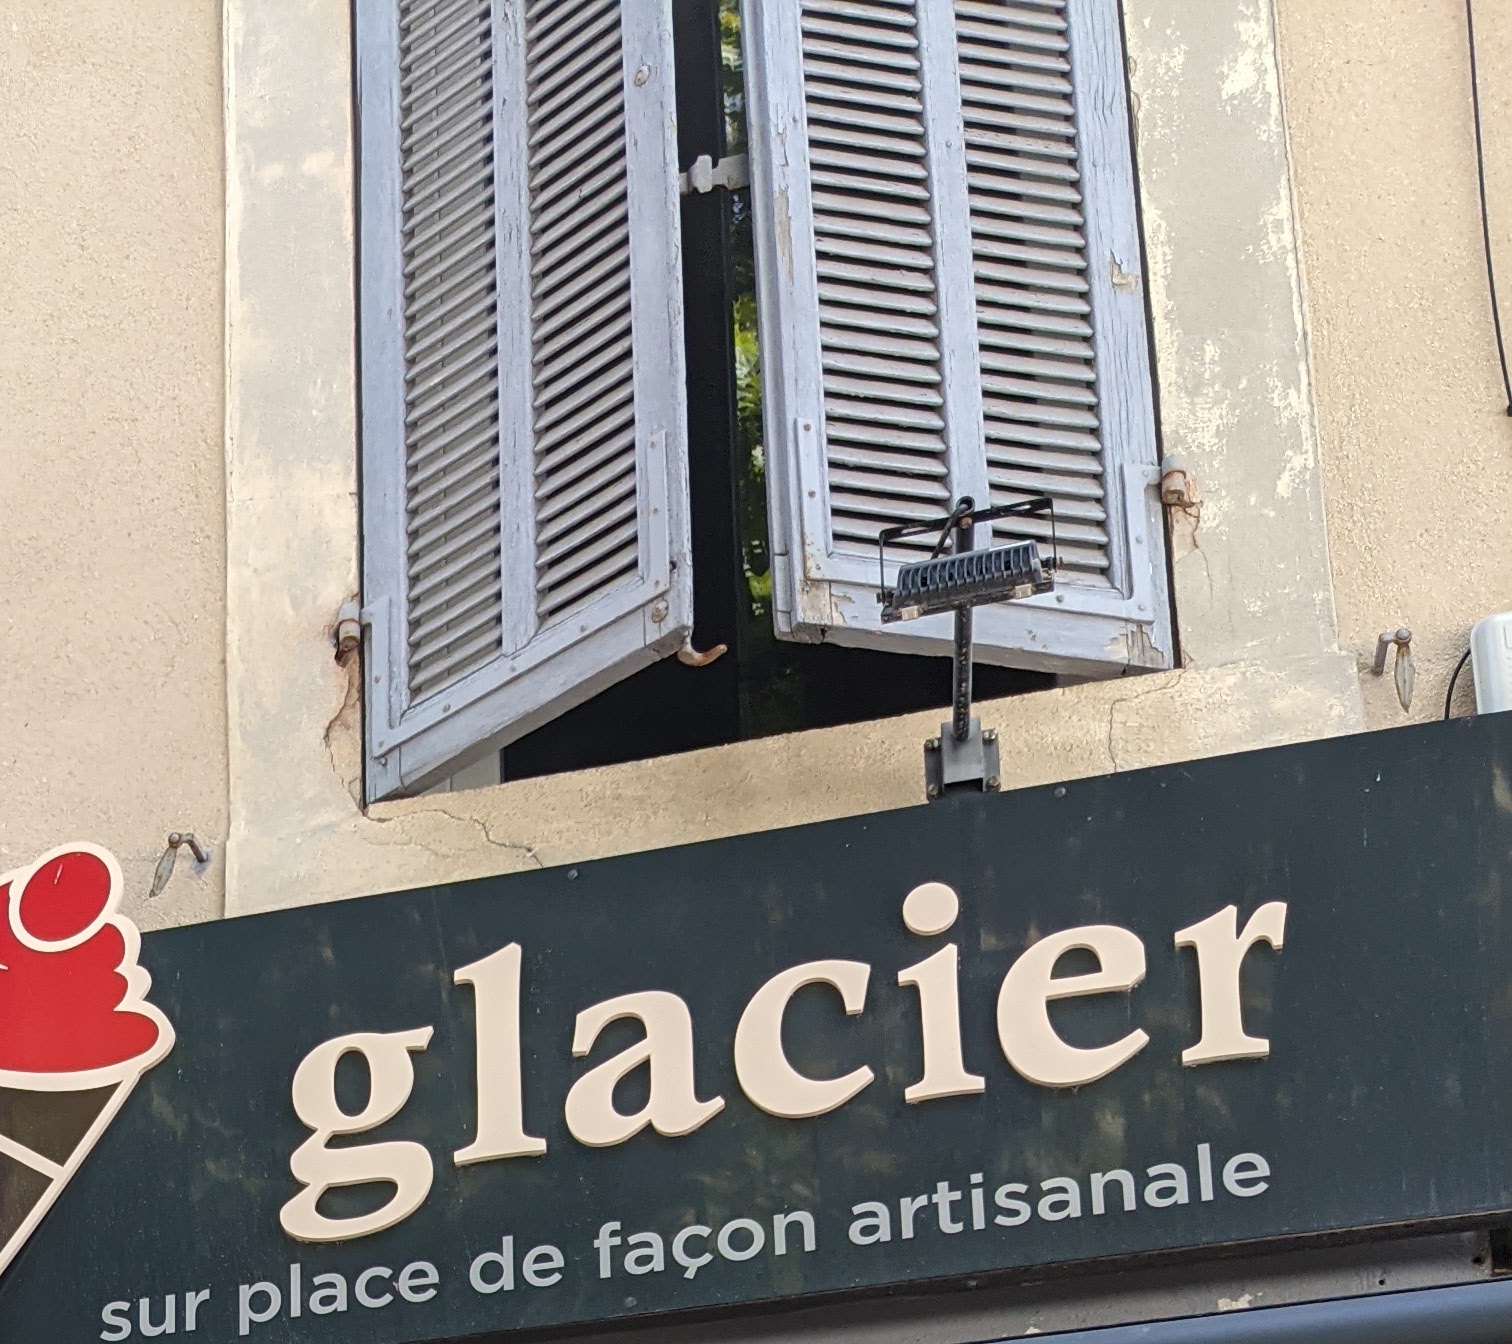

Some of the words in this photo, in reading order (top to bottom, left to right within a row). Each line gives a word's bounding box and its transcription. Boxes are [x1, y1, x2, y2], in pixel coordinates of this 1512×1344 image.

[280, 882, 1287, 1243] glacier
[100, 1290, 210, 1343] sur
[237, 1257, 438, 1336] place
[469, 1235, 564, 1294] de
[594, 1208, 817, 1282] façon
[846, 1143, 1271, 1247] artisanale
